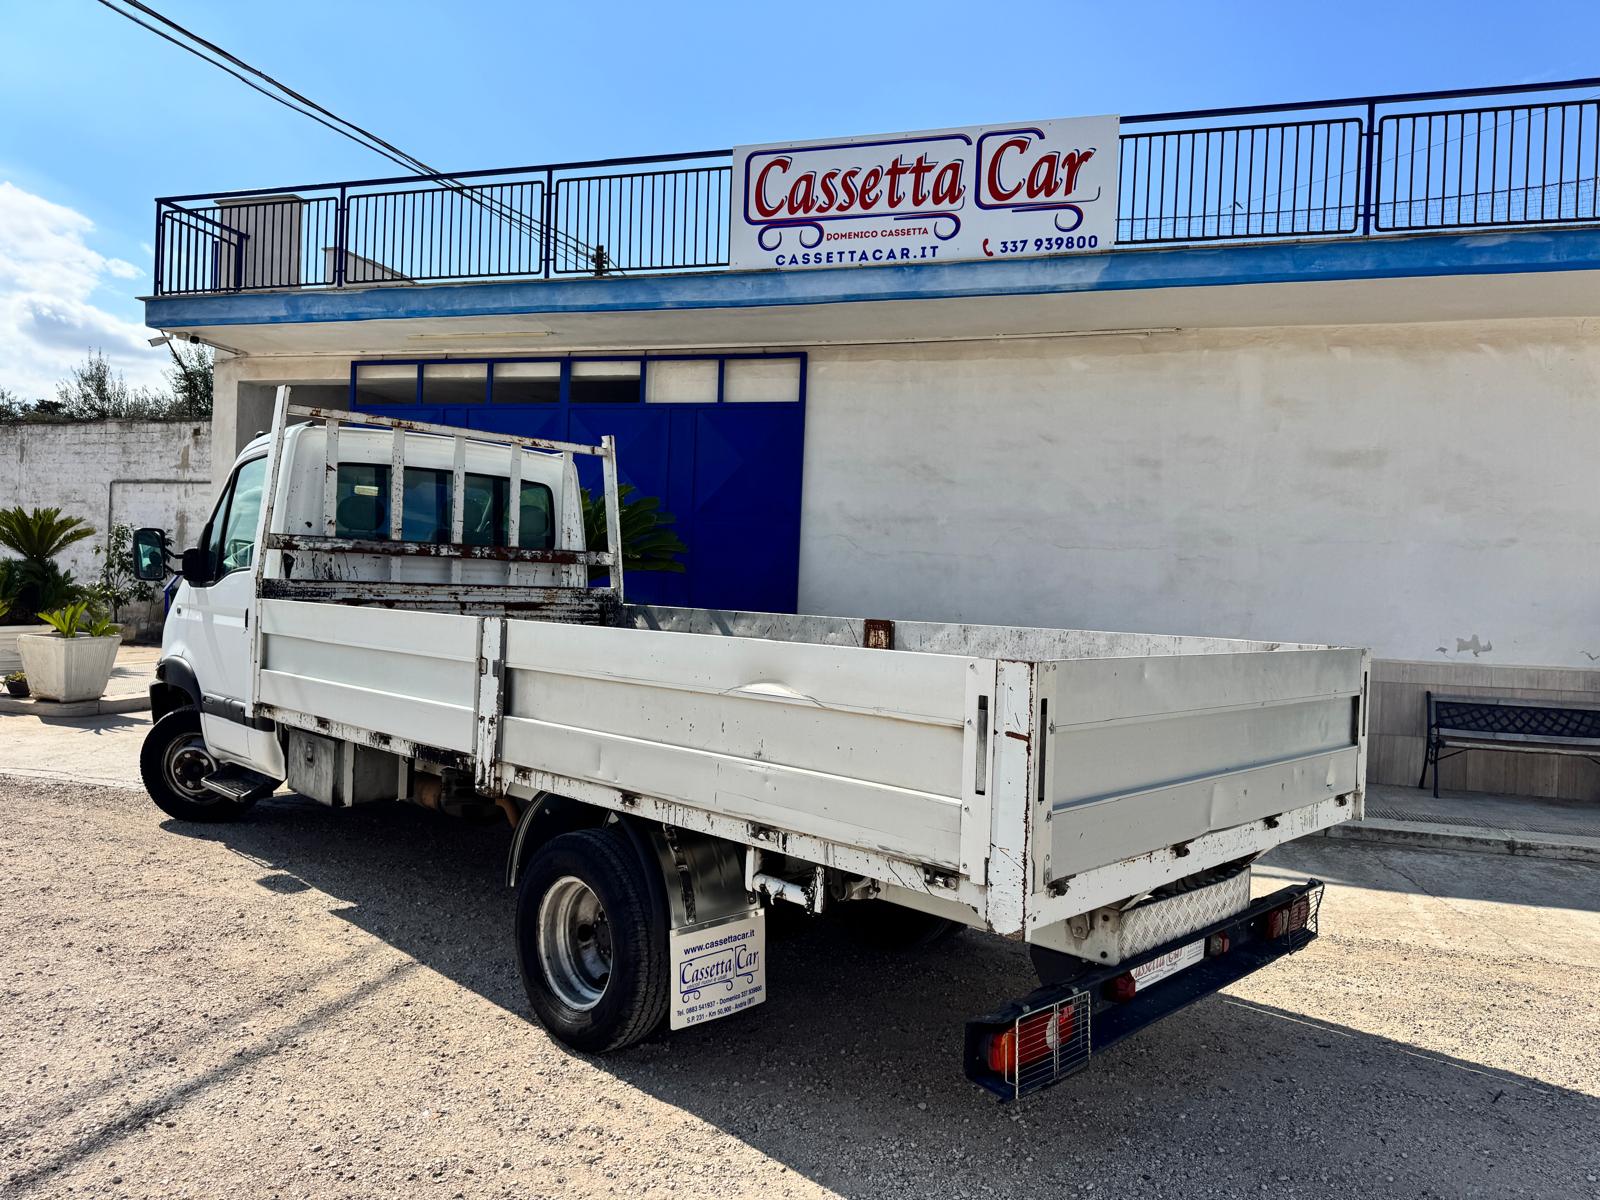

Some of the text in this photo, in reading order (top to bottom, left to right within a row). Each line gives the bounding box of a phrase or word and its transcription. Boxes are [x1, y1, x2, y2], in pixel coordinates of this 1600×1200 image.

[754, 136, 1097, 217] Cassetta Car
[826, 226, 929, 242] DOMENICO CASSETTA
[1000, 235, 1098, 254] 337 939800
[775, 245, 939, 267] CASSETTACAR.IT
[683, 929, 755, 956] www.cassettacar.it
[681, 958, 732, 984] Cassetta
[737, 947, 759, 970] Car
